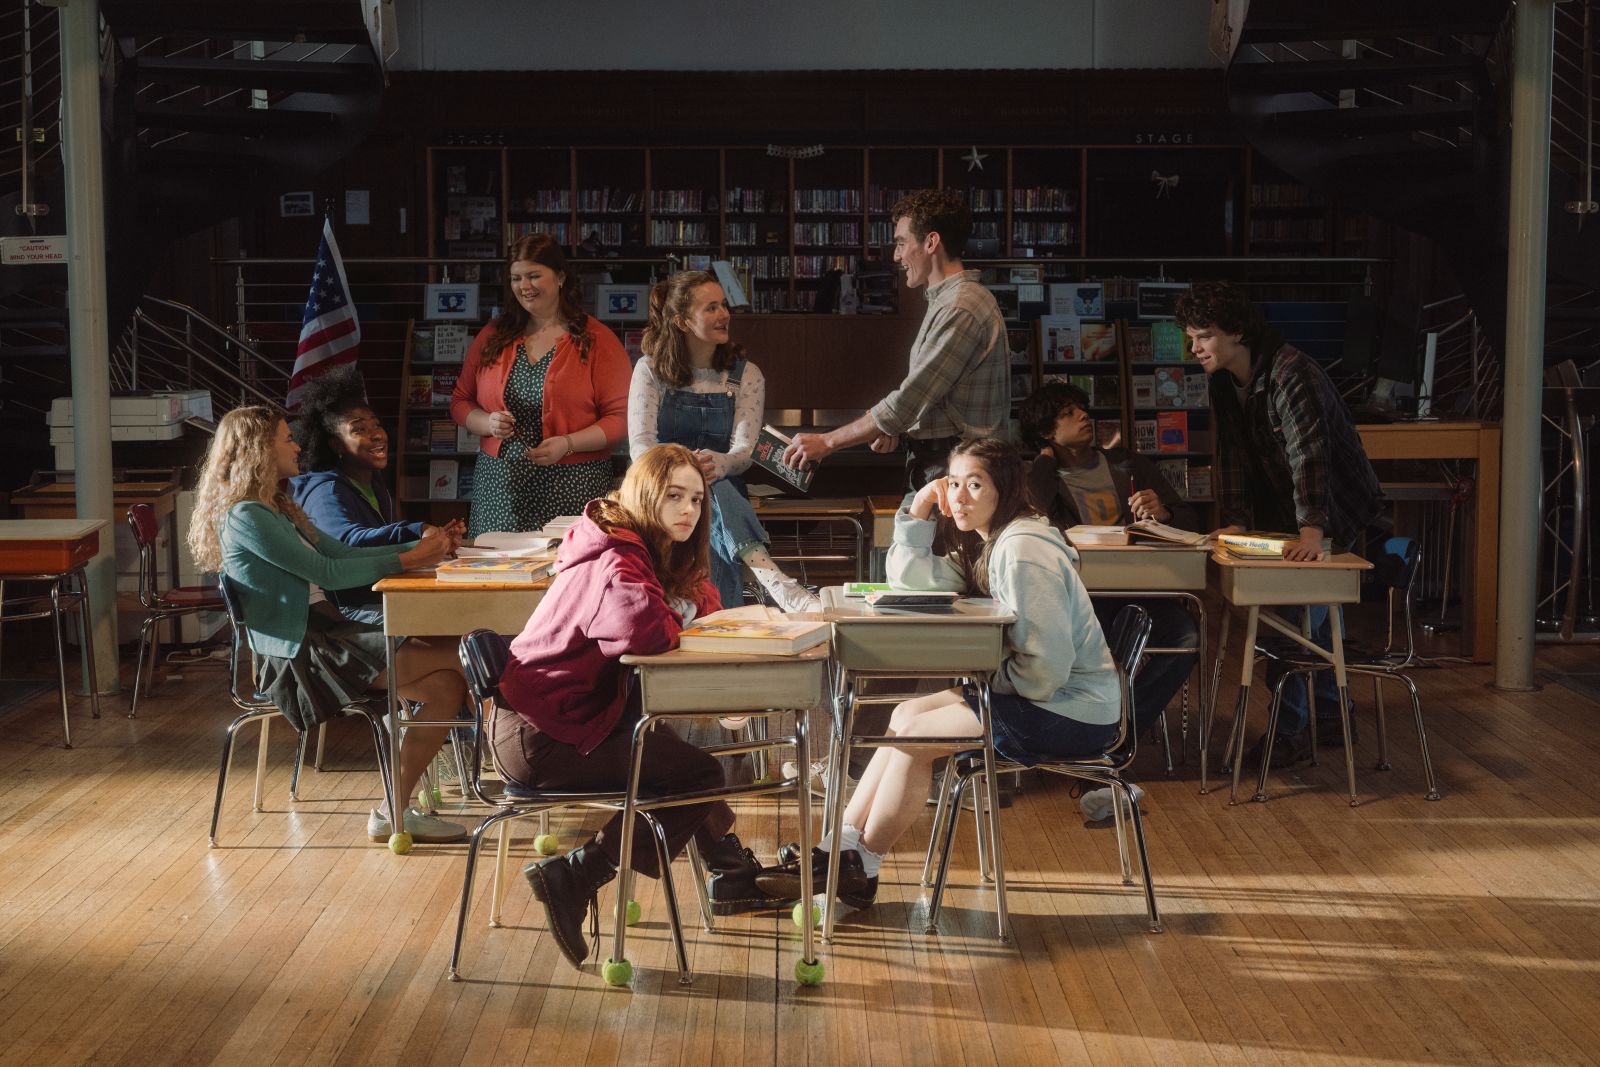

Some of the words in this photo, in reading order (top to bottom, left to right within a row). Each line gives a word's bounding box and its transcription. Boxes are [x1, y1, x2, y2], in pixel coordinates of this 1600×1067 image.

[1135, 133, 1193, 144] STAGE
[1187, 383, 1207, 392] POWER
[1135, 426, 1155, 438] HOW
[1248, 540, 1270, 550] Health
